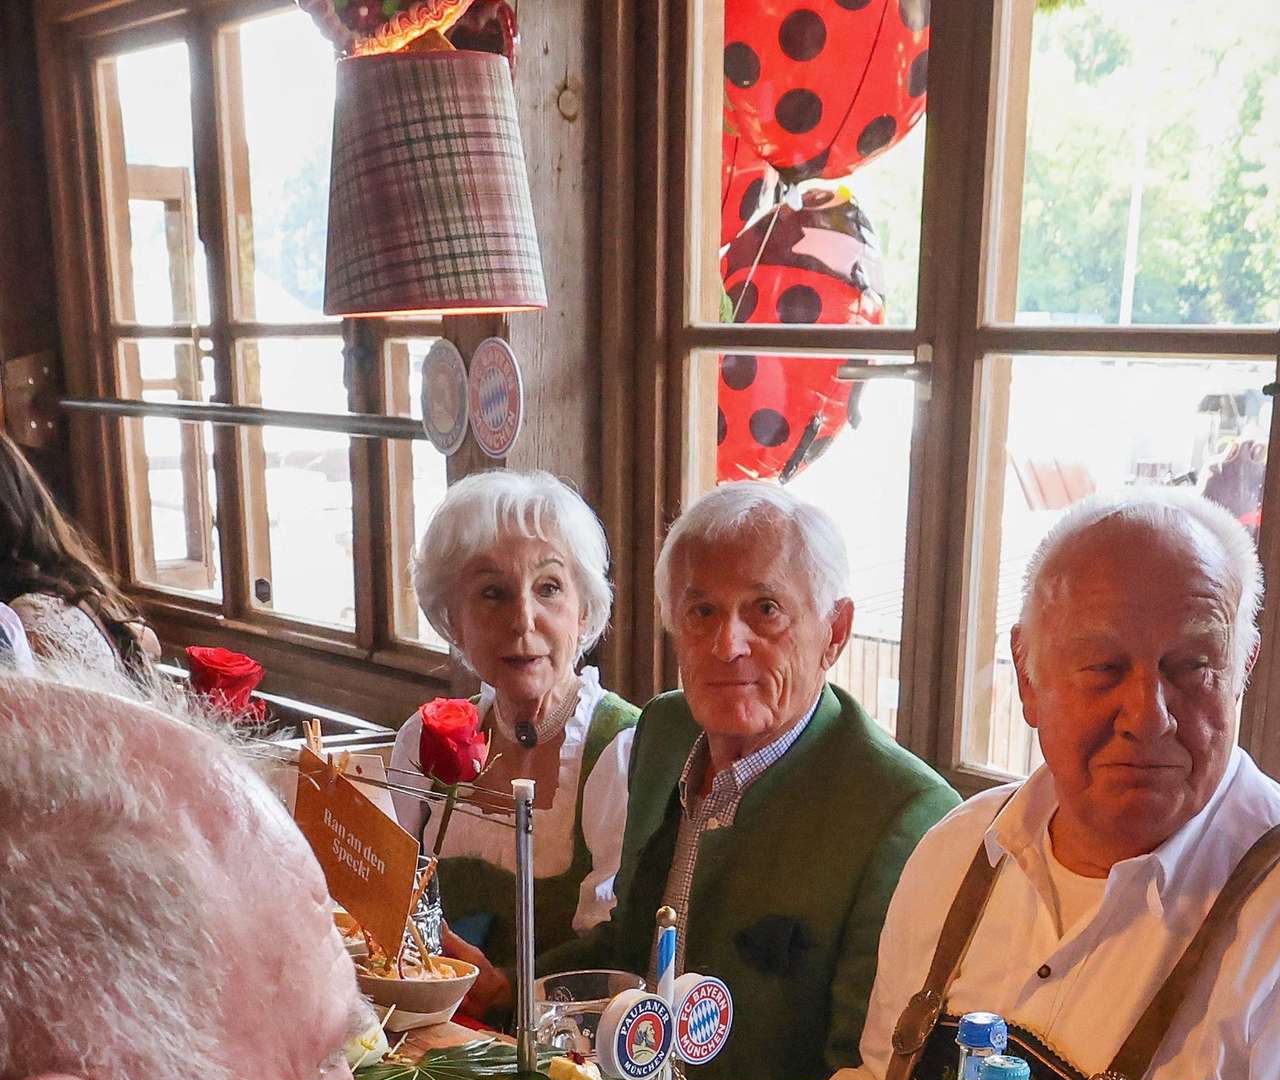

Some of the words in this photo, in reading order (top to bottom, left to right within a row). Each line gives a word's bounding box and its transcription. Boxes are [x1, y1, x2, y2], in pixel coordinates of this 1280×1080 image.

[323, 808, 346, 839] Ran
[346, 833, 362, 853] an
[363, 846, 385, 875] den
[332, 838, 370, 882] Speck!
[621, 1000, 670, 1036] PAULANER
[681, 1001, 693, 1022] FC
[692, 984, 728, 1011] BAYERN
[680, 1023, 727, 1057] MÜNCHEN
[623, 1050, 666, 1076] MÜNCHEN
